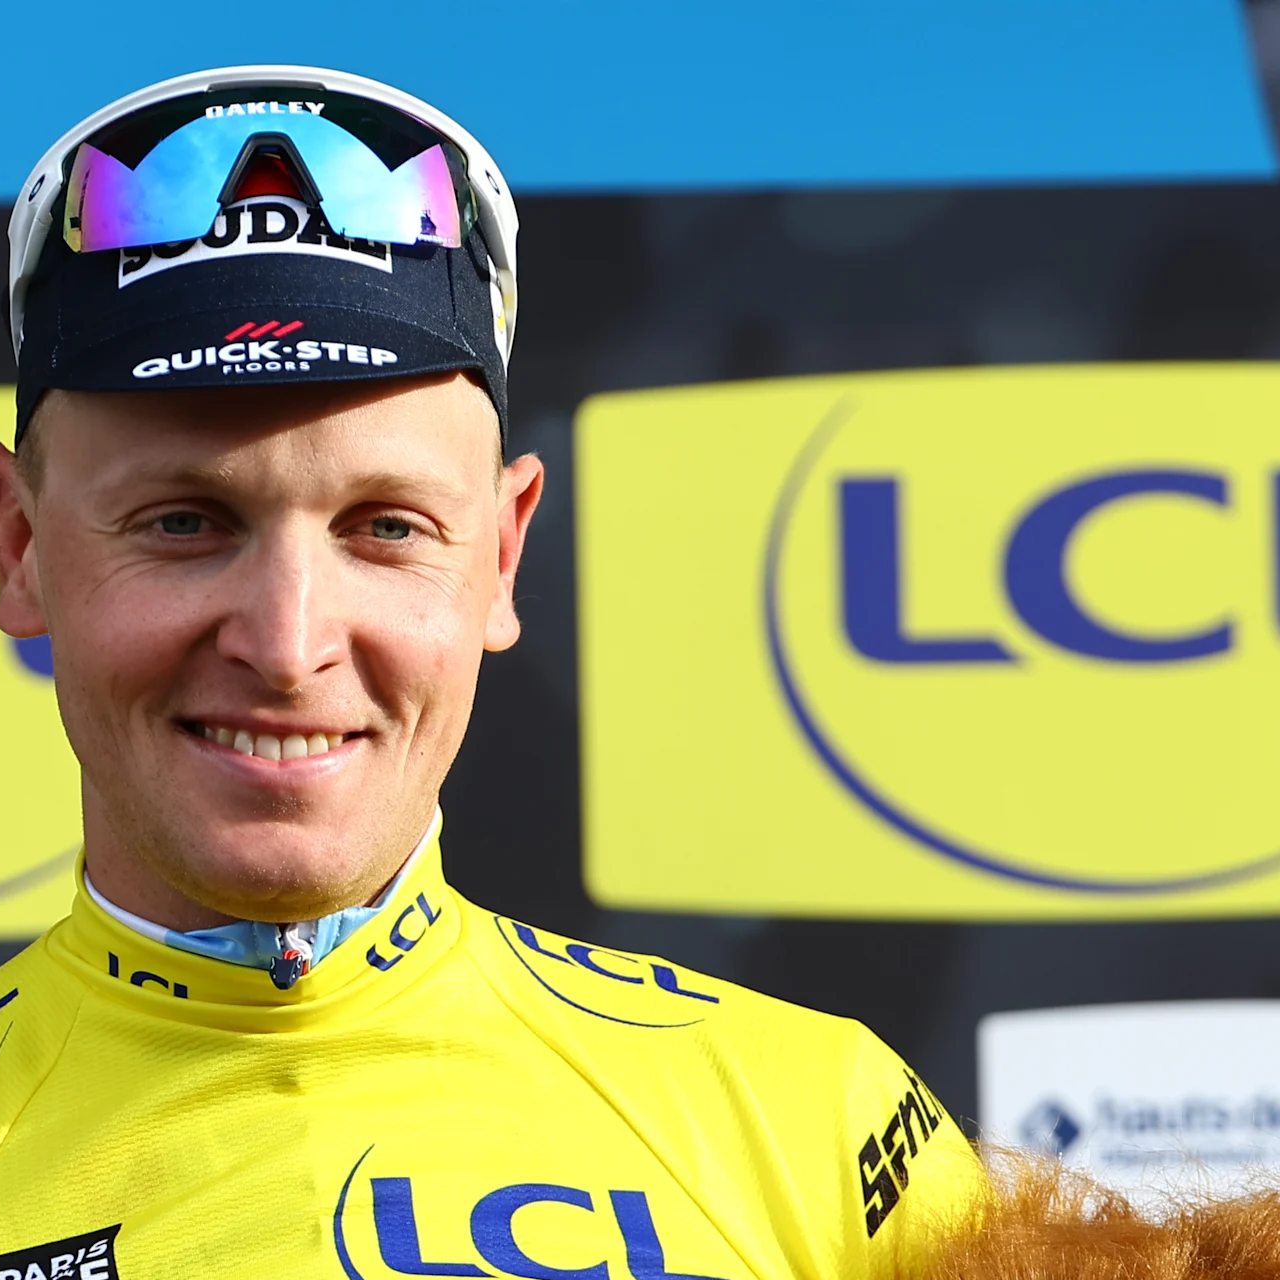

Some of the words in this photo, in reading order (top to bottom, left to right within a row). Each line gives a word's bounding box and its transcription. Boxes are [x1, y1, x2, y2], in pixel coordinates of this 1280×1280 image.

[205, 101, 325, 119] OAKLEY
[222, 361, 311, 375] FLOORS
[511, 921, 720, 1004] LCL
